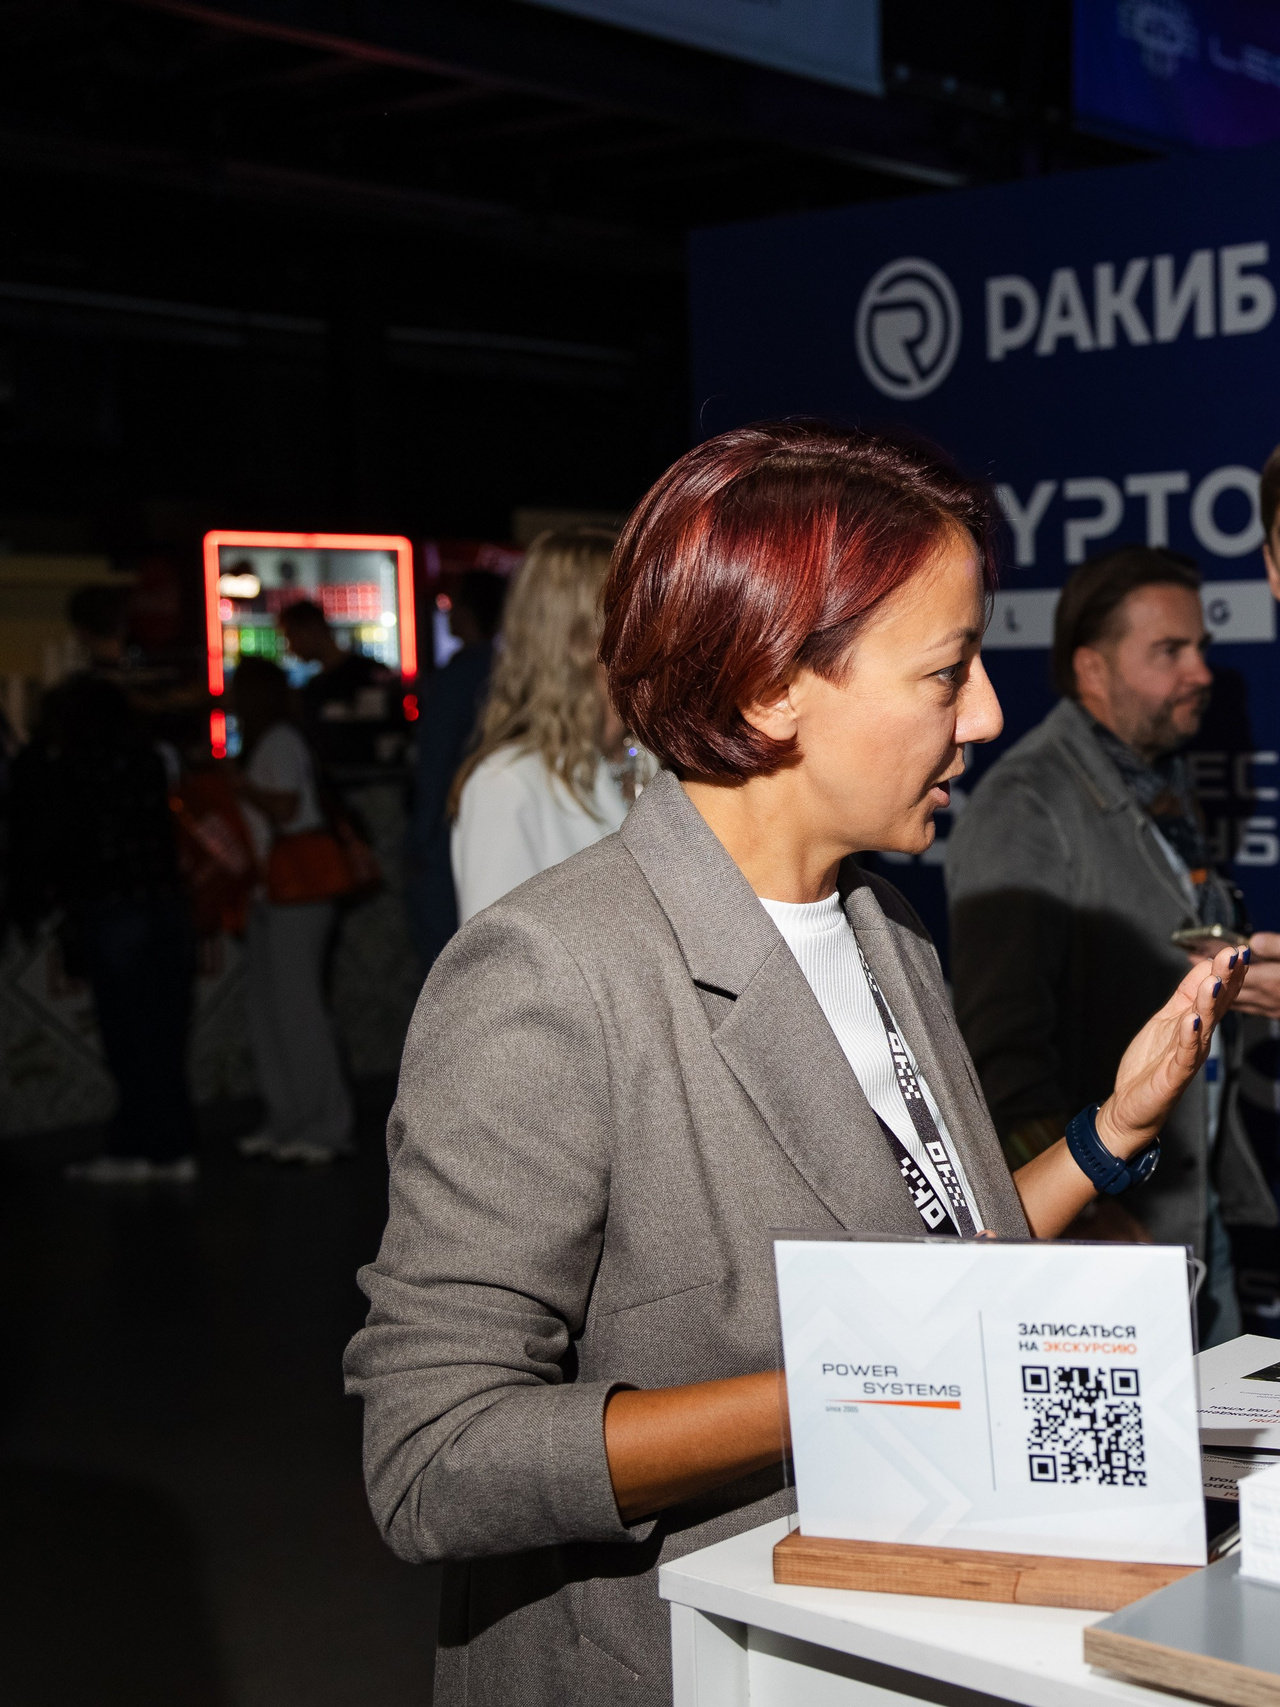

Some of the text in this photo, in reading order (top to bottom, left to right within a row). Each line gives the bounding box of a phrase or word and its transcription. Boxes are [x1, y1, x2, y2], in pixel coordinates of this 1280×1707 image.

[985, 242, 1276, 361] РАКИБ
[994, 465, 1263, 567] YPTO
[1018, 1323, 1137, 1339] ЗАПИСАТЬСЯ
[1018, 1340, 1138, 1355] НА ЭКСКУРСИЮ
[822, 1363, 899, 1377] POWER
[863, 1382, 962, 1398] SYSTEMS
